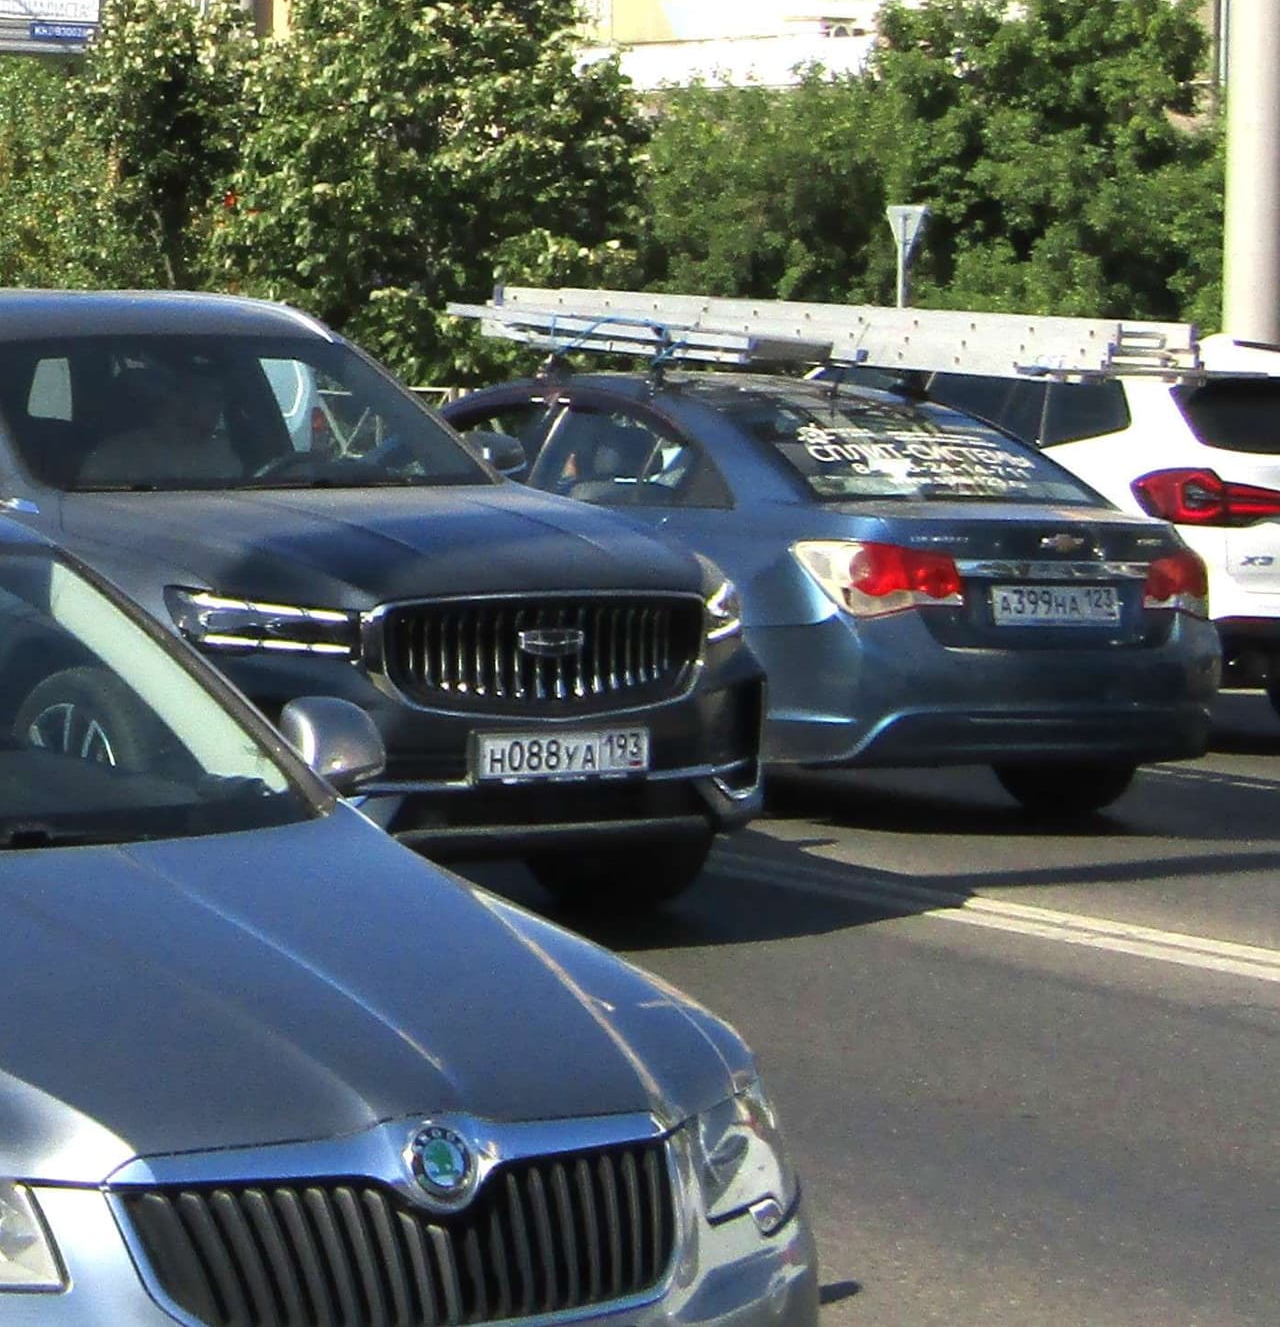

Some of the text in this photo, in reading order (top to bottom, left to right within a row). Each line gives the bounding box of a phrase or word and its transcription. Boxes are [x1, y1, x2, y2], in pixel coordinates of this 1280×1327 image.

[1000, 590, 1114, 615] А399НА 123
[490, 732, 641, 772] Н088УА 193
